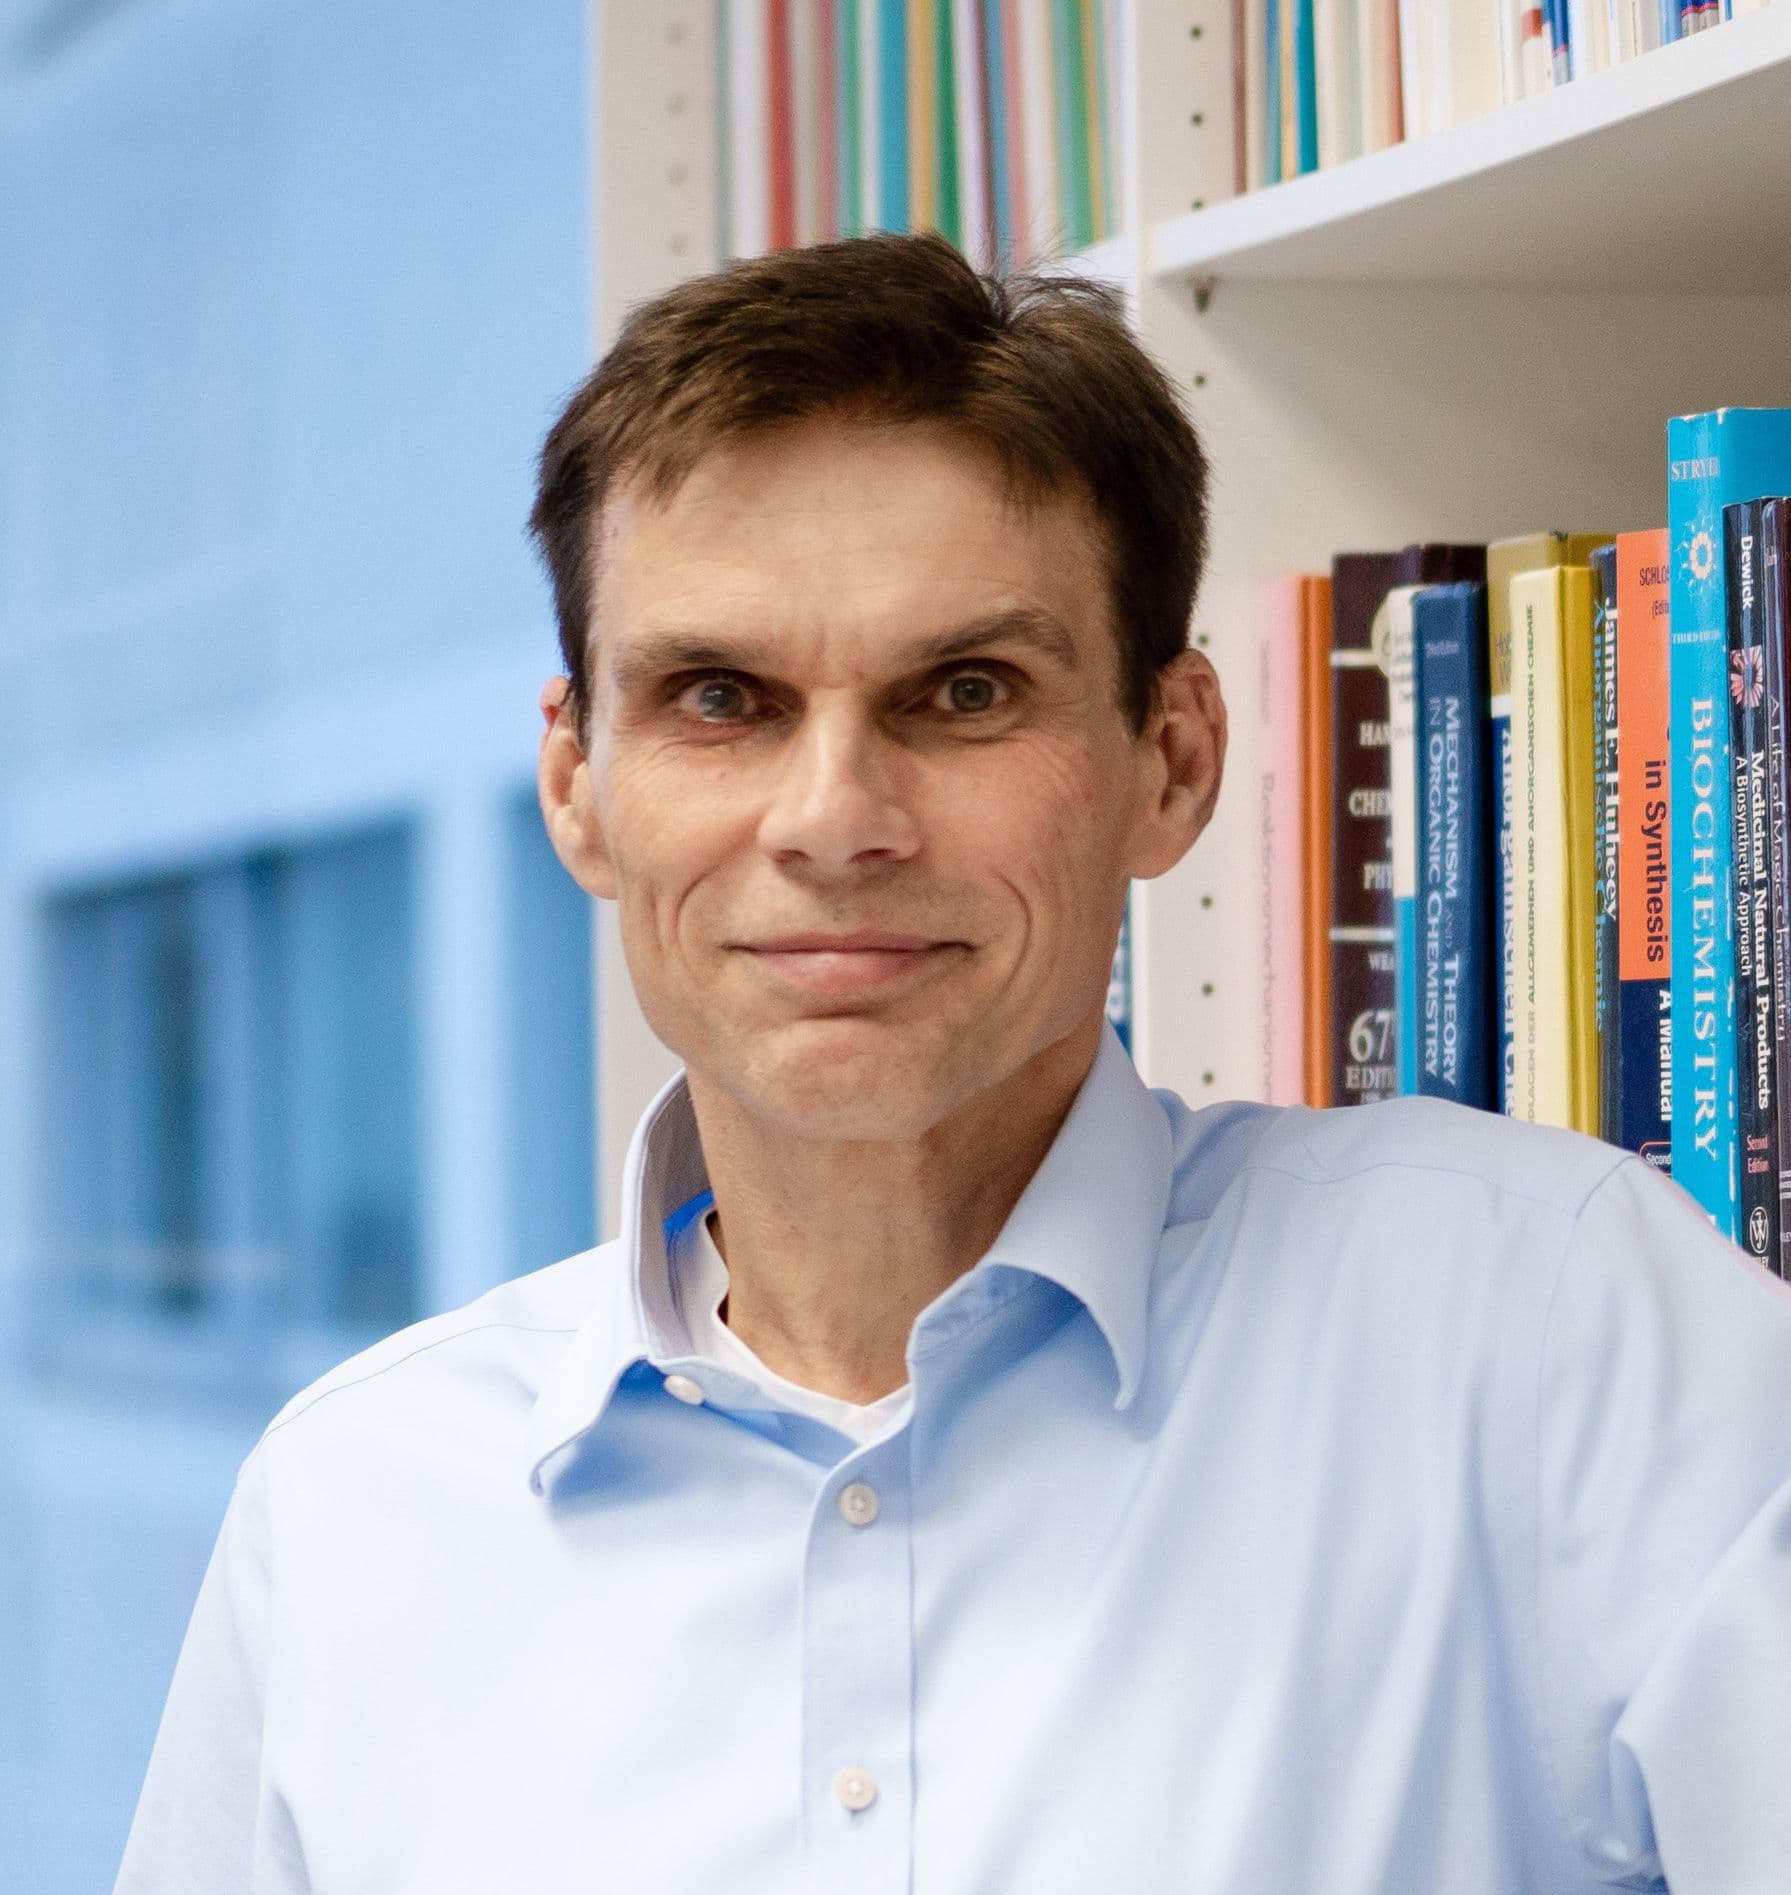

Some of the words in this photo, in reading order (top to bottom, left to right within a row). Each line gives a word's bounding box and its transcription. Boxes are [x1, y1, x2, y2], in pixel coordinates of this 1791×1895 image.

[1741, 534, 1755, 611] Dewick
[1526, 605, 1535, 668] CHEMIE
[1604, 597, 1619, 722] James
[1430, 697, 1441, 725] IN
[1527, 675, 1535, 831] ANORGANISCHEN
[1604, 728, 1620, 767] E.
[1770, 695, 1780, 717] A
[1770, 726, 1784, 774] Life
[1429, 733, 1443, 884] ORGANIC
[1445, 697, 1461, 898] MECHANISM
[1646, 759, 1667, 788] in
[1736, 756, 1748, 770] A
[1752, 749, 1767, 882] Medicinal
[1772, 782, 1785, 814] of
[1527, 838, 1535, 872] UND
[1603, 770, 1621, 921] Huheey
[1641, 801, 1667, 961] Synthesis
[1735, 775, 1750, 885] Biosynthetic
[1771, 820, 1784, 898] Magic
[1262, 772, 1277, 1102] Reaktionsmechanisme
[1527, 881, 1536, 1004] ALLGEMEINEN
[1595, 879, 1609, 1032] Chemie
[1692, 699, 1717, 1161] BIOCHEMISTRY
[1738, 892, 1752, 976] Approach
[1754, 887, 1769, 988] Natural
[1774, 905, 1787, 1042] Chemistry
[1425, 890, 1442, 1077] CHEMISTRY
[1443, 952, 1459, 1086] THEORY
[1659, 990, 1673, 1010] A
[1659, 1019, 1673, 1121] Manual
[1757, 995, 1771, 1110] Products
[1747, 1157, 1770, 1174] Edition
